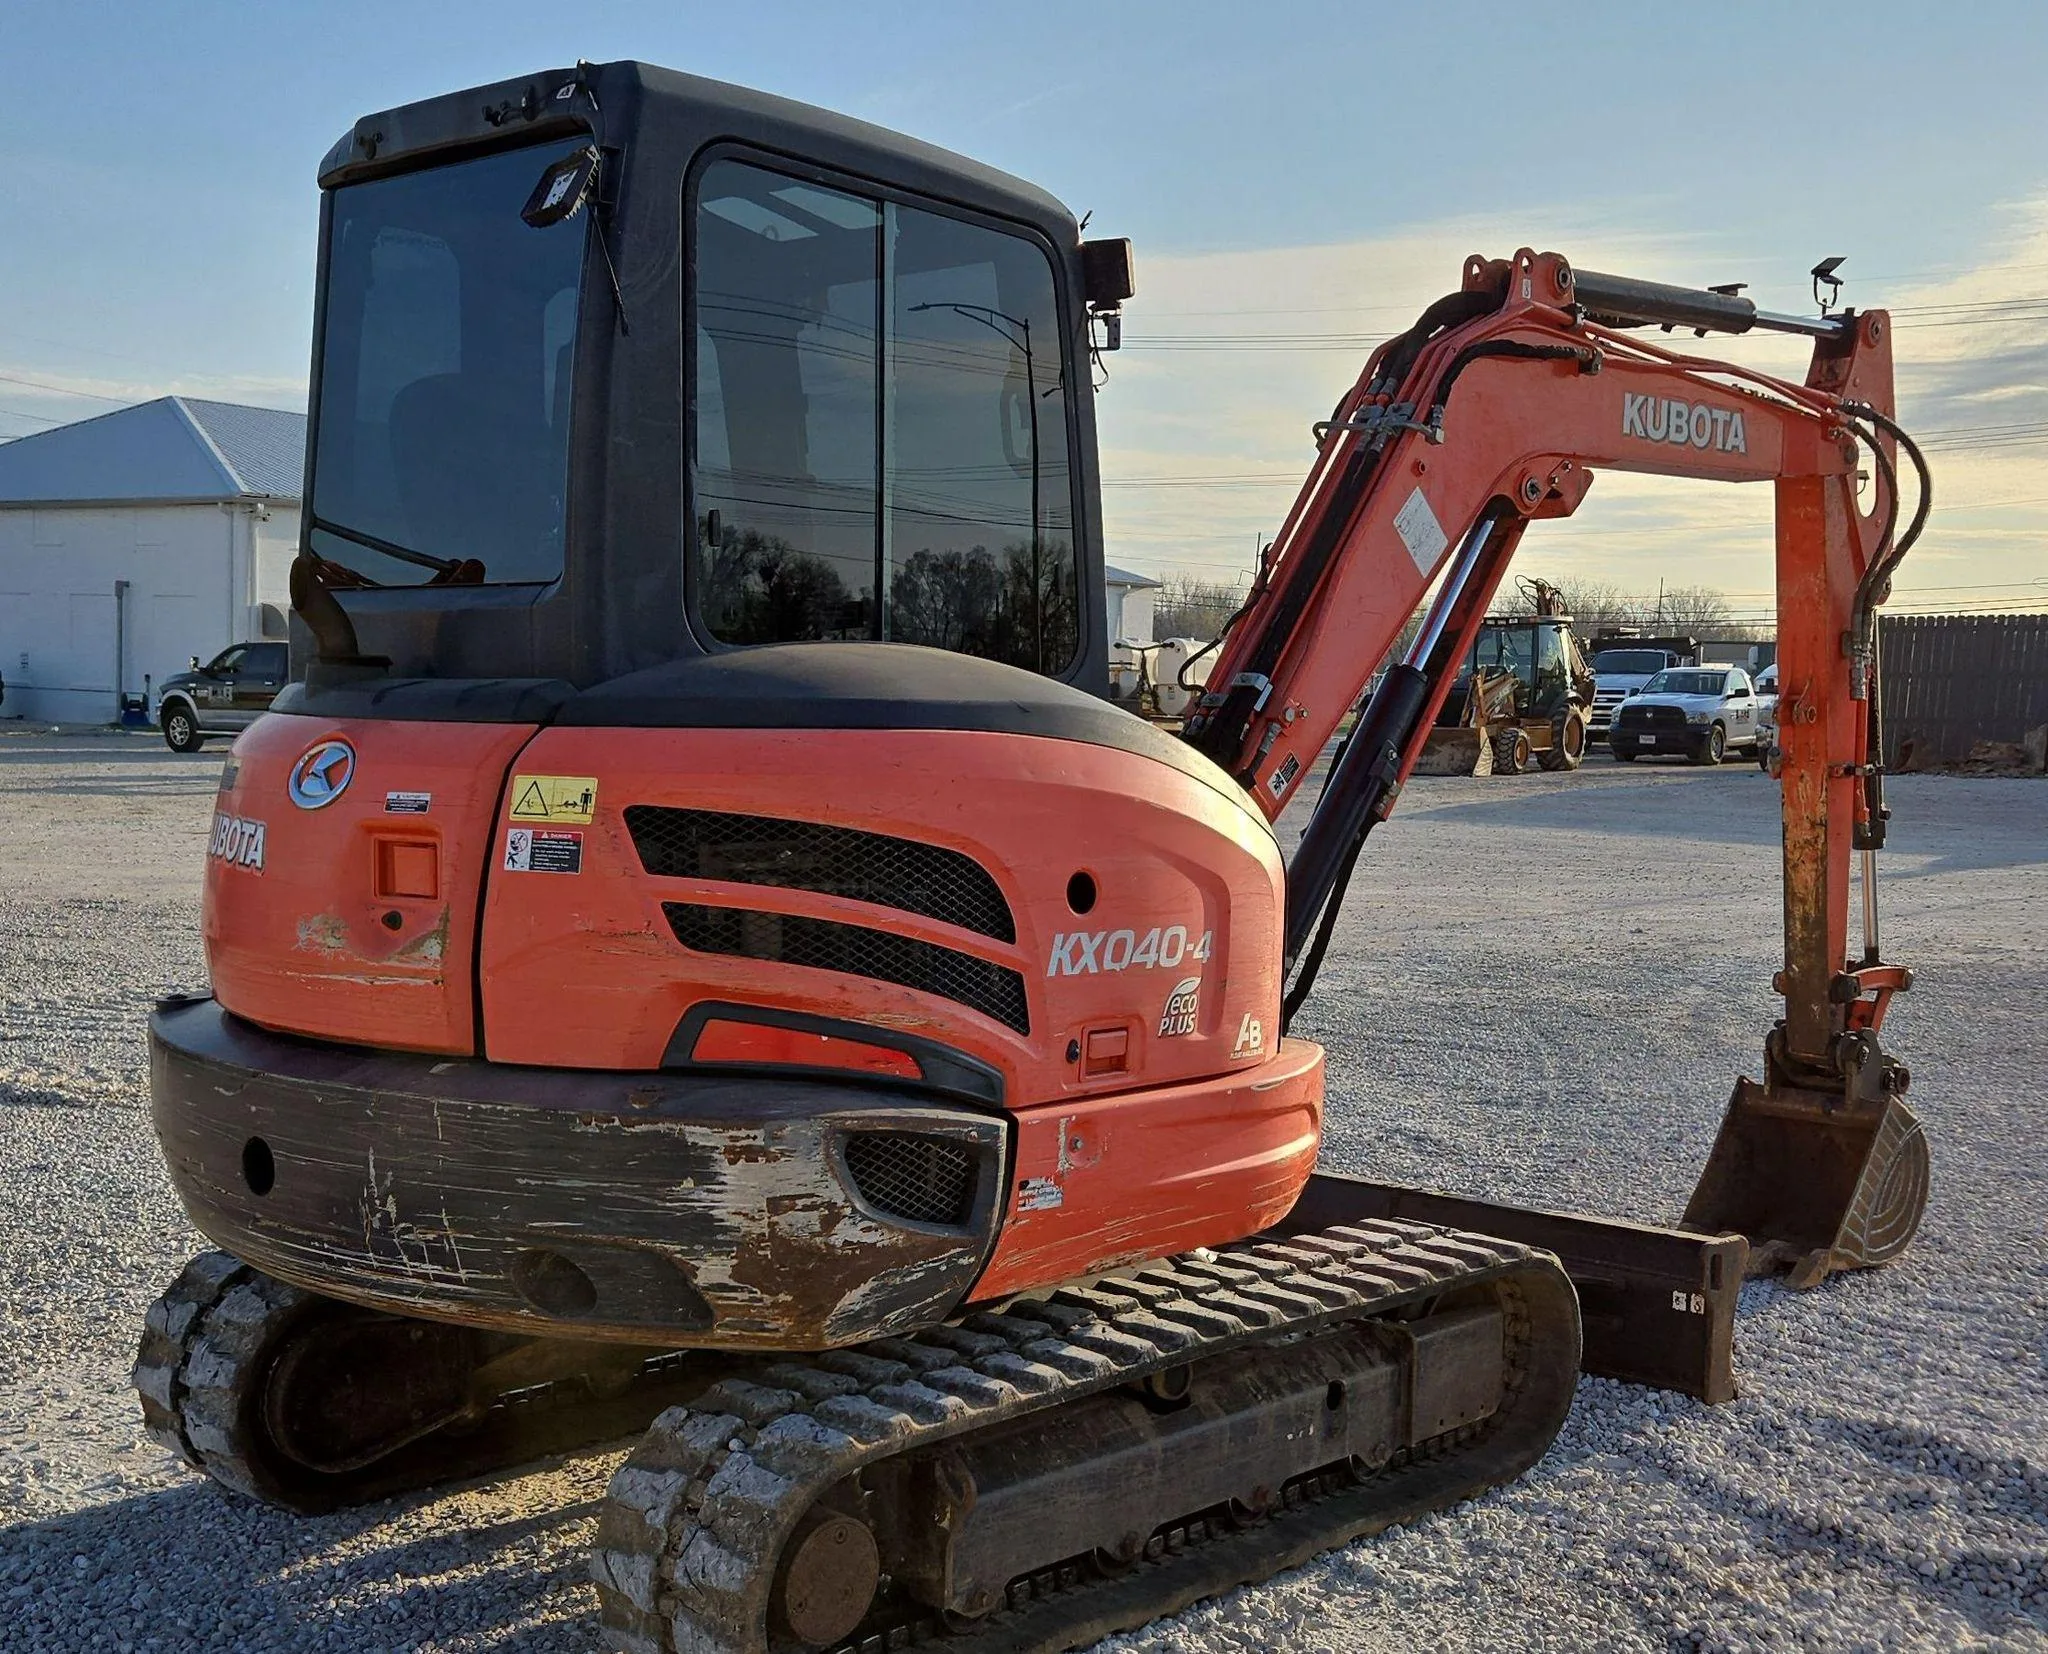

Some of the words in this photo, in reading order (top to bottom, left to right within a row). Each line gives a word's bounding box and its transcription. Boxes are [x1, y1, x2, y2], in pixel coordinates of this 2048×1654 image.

[1622, 391, 1747, 454] KUBOTA
[1047, 925, 1213, 977] KX040-4
[1170, 995, 1198, 1015] eco
[1158, 1013, 1197, 1038] PLUS
